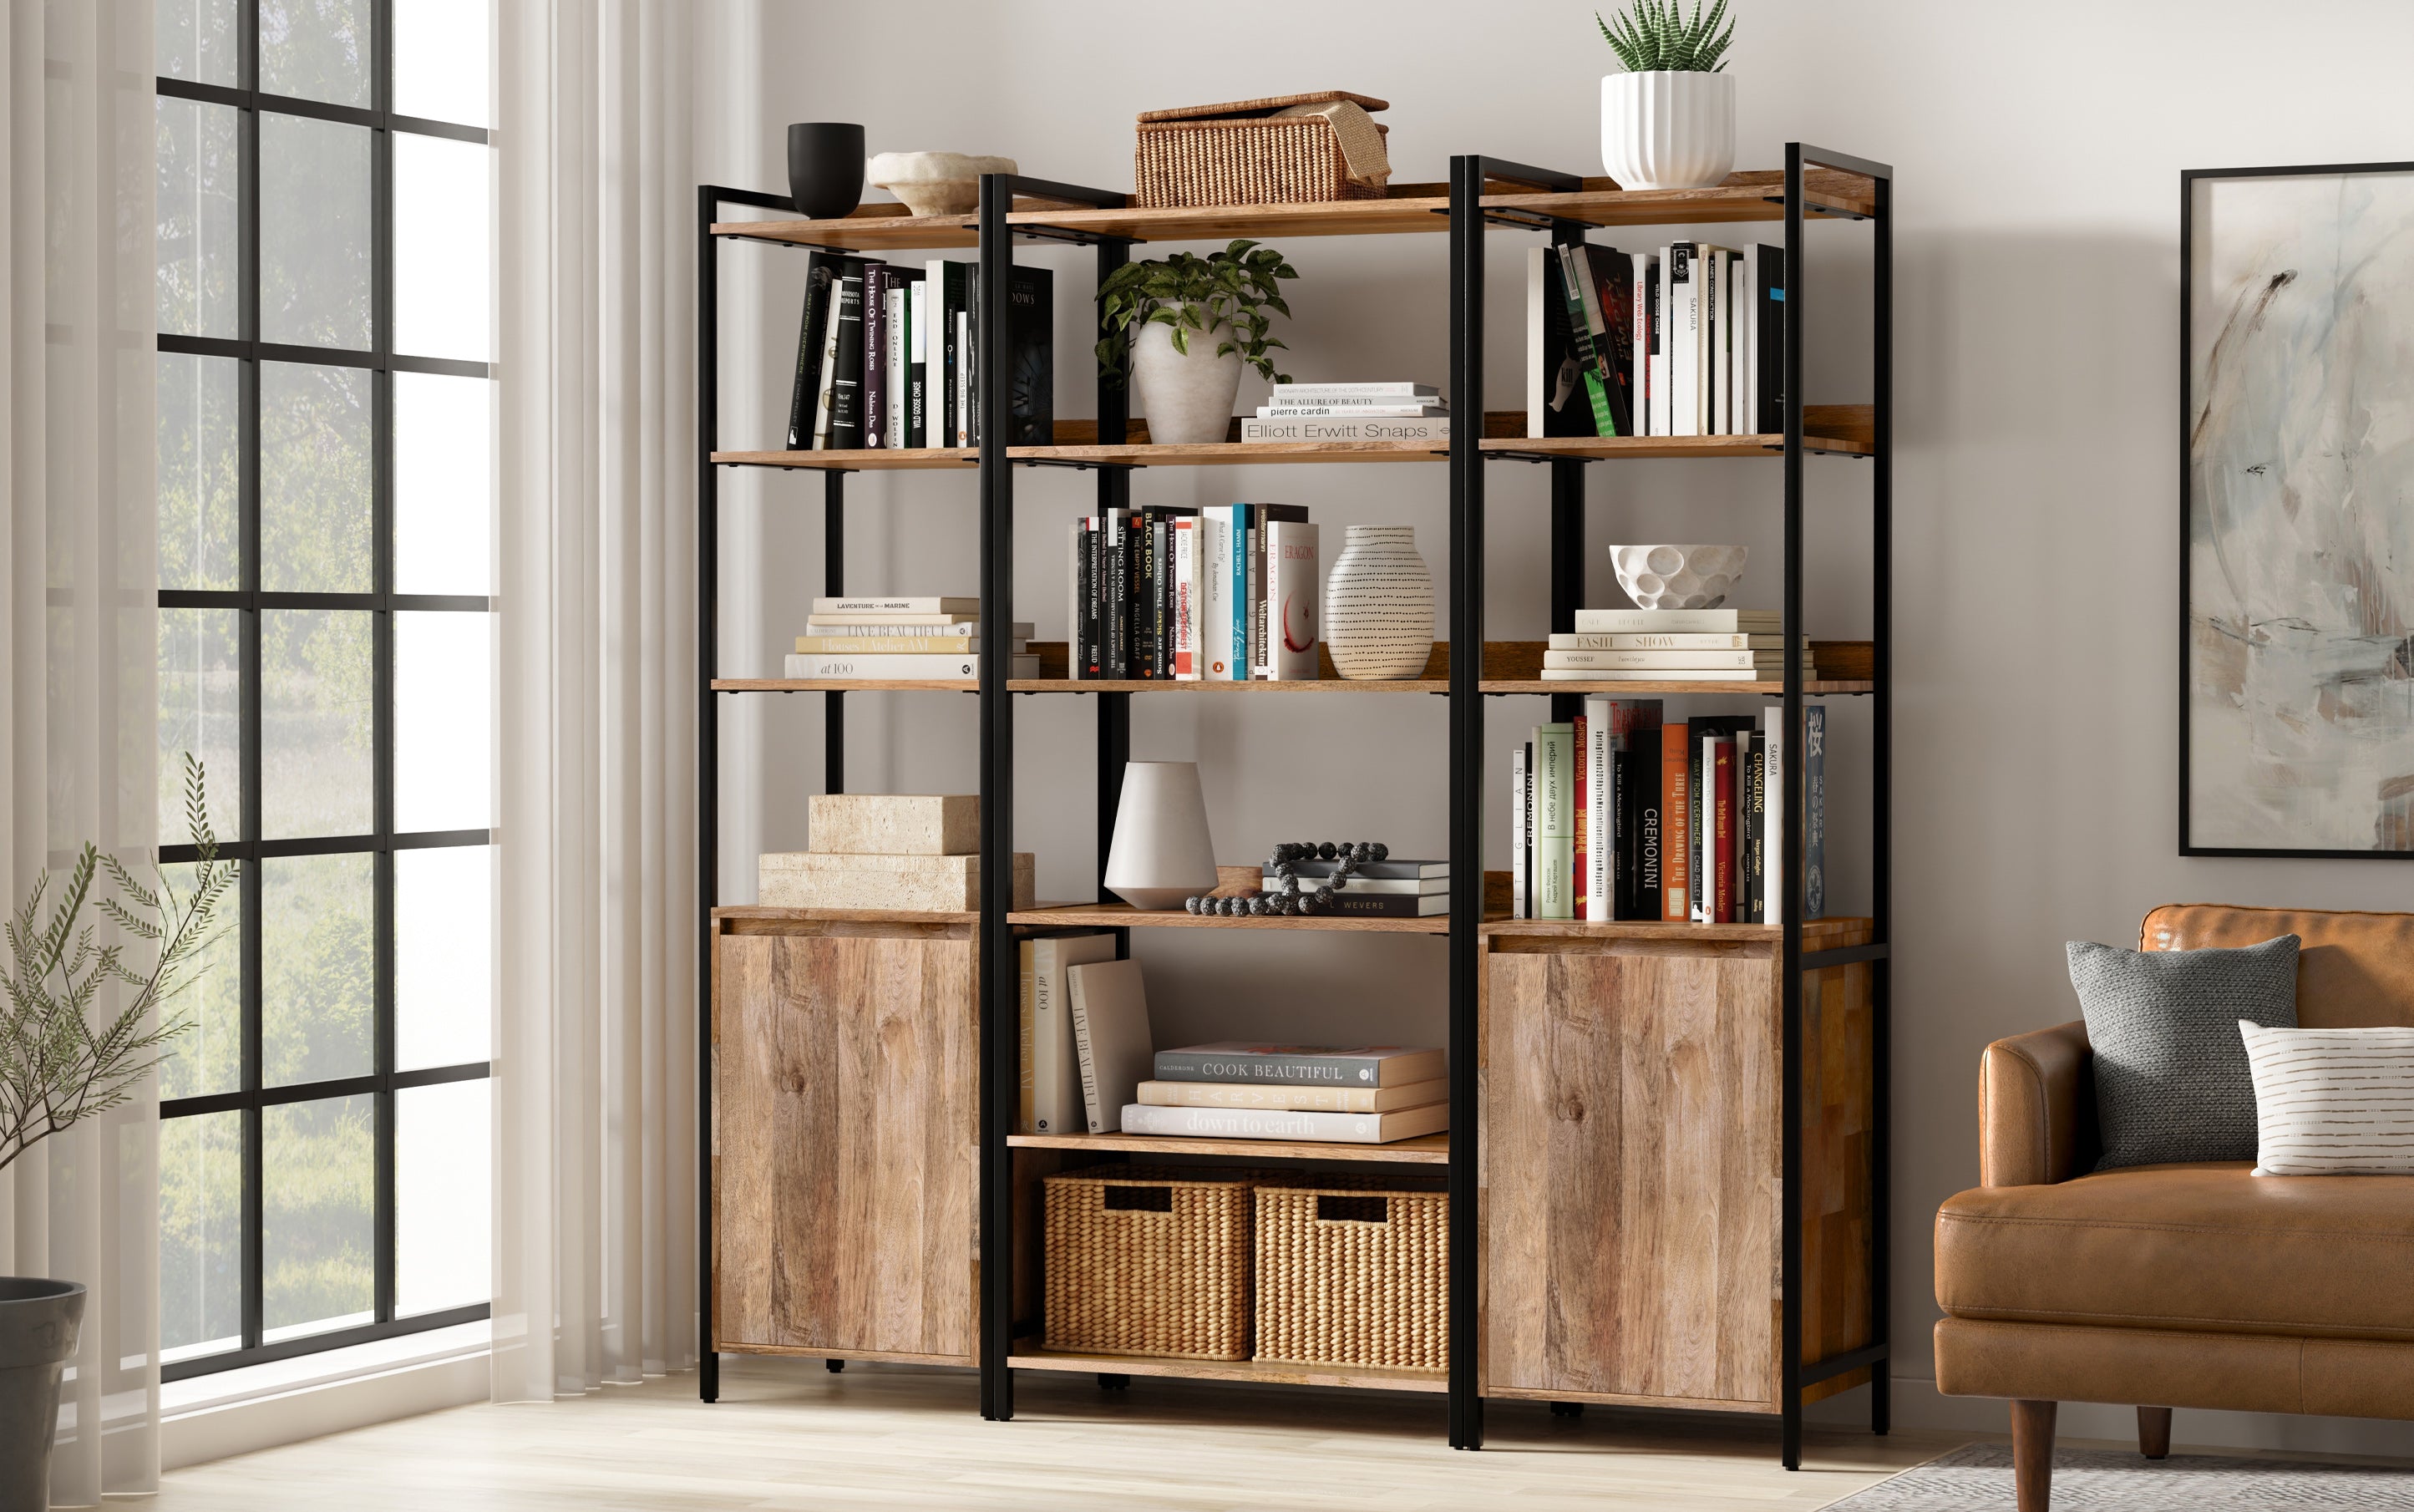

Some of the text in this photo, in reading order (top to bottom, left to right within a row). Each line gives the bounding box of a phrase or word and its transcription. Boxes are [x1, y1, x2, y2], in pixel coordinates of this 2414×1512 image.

[882, 271, 900, 288] THE
[913, 382, 921, 429] WILD GOOSE CHASE
[1270, 407, 1330, 417] pierre cardin
[1248, 424, 1428, 439] Elliott Erwitt Snaps
[1285, 545, 1314, 560] ERAGON
[849, 626, 948, 637] LIVE BEAUTIFUL
[1259, 600, 1267, 666] Weltarchitektur
[822, 637, 928, 652] Houses Atelier AM
[1636, 637, 1676, 647] SHOW
[821, 662, 853, 674] at 100
[1808, 713, 1822, 757] 桜
[1547, 741, 1557, 777] империй
[1576, 721, 1587, 781] Victoria Mosley
[1617, 764, 1621, 773] To
[1747, 764, 1751, 774] To
[1549, 781, 1557, 799] двух
[1672, 773, 1685, 798] THREE
[1754, 753, 1762, 813] CHANGELING
[1676, 800, 1685, 814] THE
[1676, 818, 1685, 827] OF
[1645, 809, 1657, 889] CREMONINI
[1672, 830, 1685, 863] DRAWING
[1672, 867, 1685, 882] THE
[1022, 972, 1032, 1013] Houses
[1038, 977, 1048, 1010] at 100
[1073, 1007, 1097, 1111] LIVE BEAUTIFUL
[1203, 1063, 1248, 1076] COOK
[1255, 1064, 1343, 1080] BEAUTIFUL
[1187, 1111, 1237, 1132] down
[1243, 1116, 1260, 1133] to
[1265, 1114, 1316, 1134] earth
